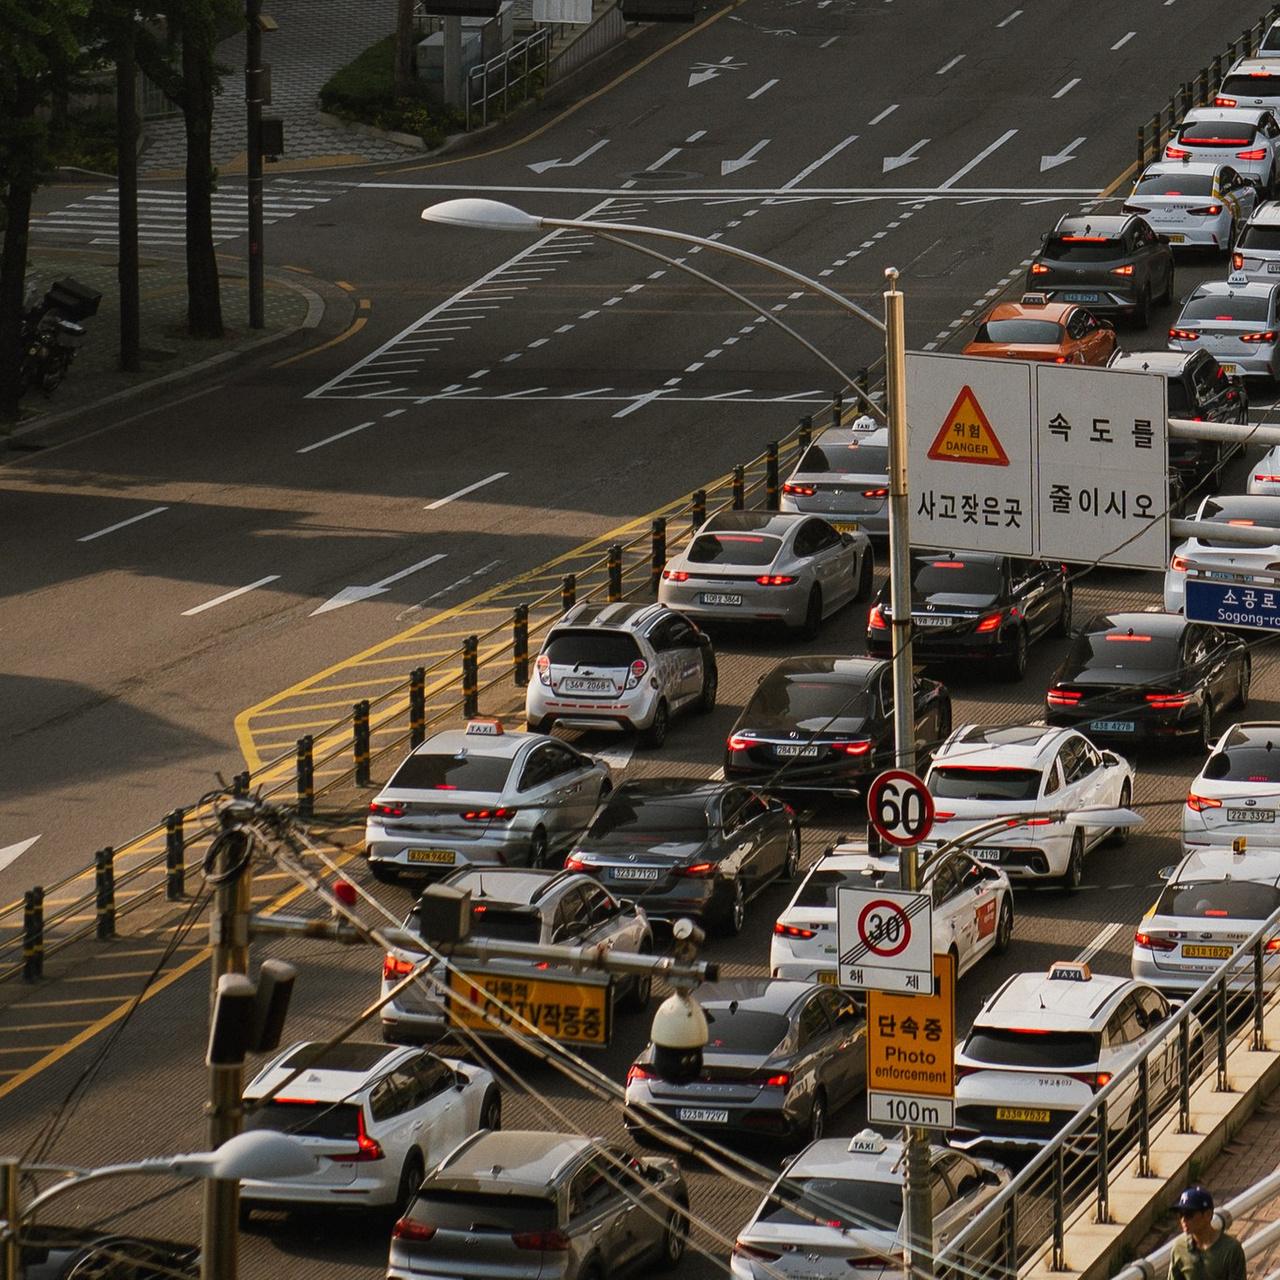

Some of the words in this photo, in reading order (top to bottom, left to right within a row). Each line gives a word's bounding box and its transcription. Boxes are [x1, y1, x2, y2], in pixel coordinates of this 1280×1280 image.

[953, 422, 981, 439] 위험
[1048, 412, 1155, 450] 속도를
[946, 441, 989, 455] DANGER
[917, 491, 1023, 529] 사고잦은곳
[1049, 484, 1156, 520] 줄이시오
[1223, 589, 1278, 609] 소공로
[471, 725, 492, 733] TAXI
[1111, 722, 1131, 731] 4278
[875, 783, 926, 836] 60
[870, 913, 901, 944] 30
[1055, 970, 1079, 979] TAXI
[878, 1015, 943, 1042] 단속중
[886, 1046, 936, 1067] Photo
[876, 1065, 948, 1084] enforcement
[887, 1100, 941, 1124] 100m
[854, 1142, 874, 1150] TAXI
